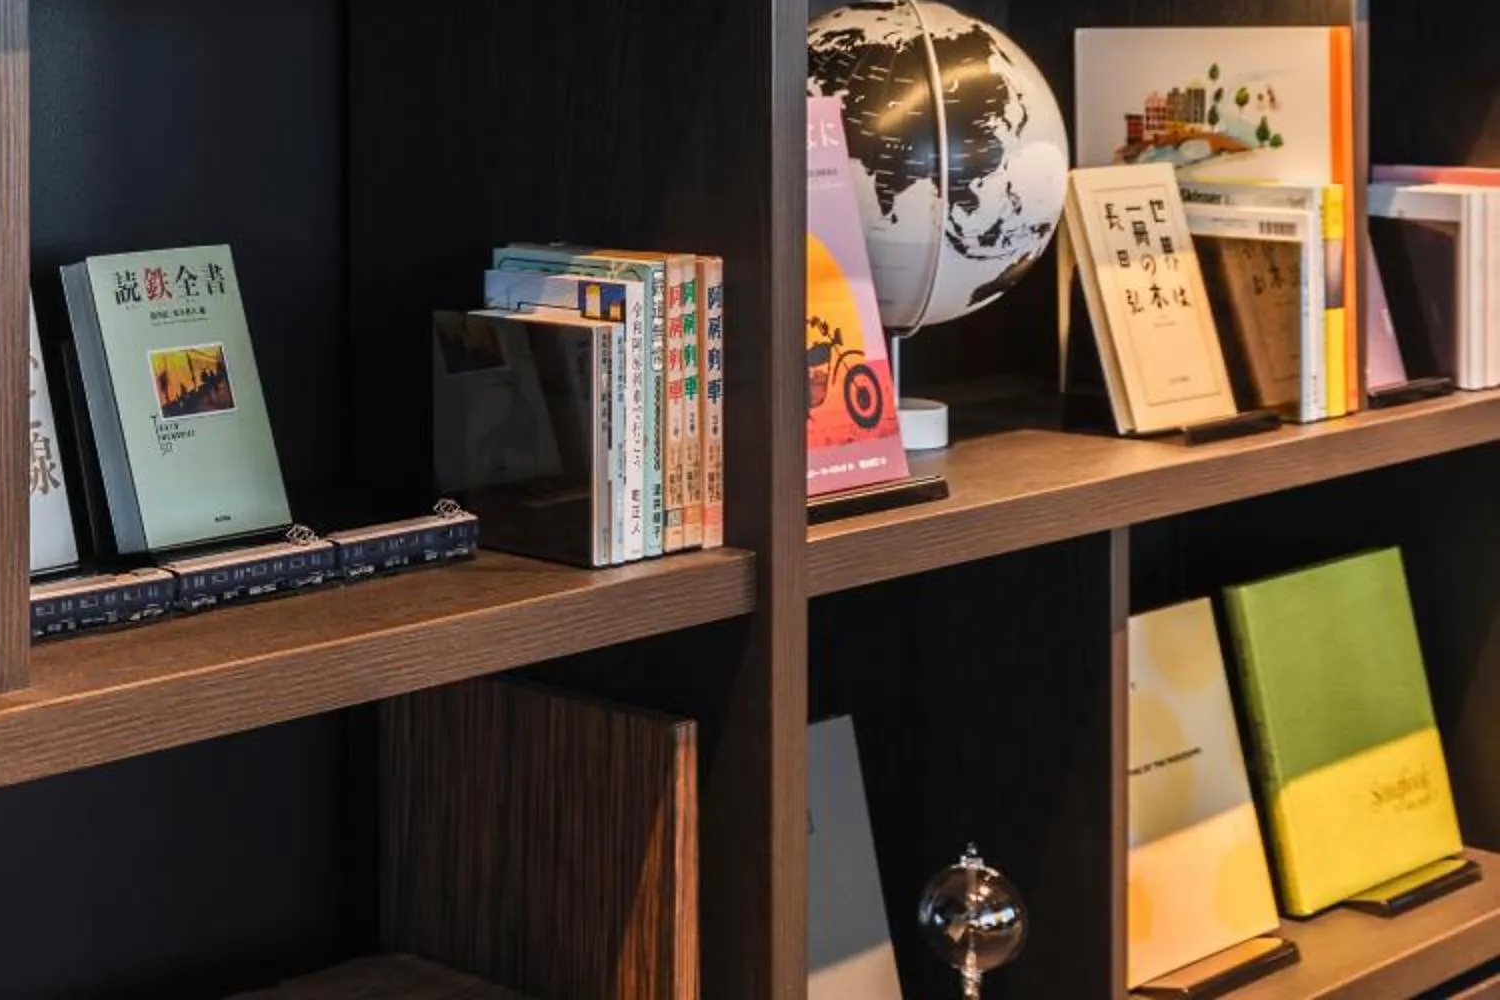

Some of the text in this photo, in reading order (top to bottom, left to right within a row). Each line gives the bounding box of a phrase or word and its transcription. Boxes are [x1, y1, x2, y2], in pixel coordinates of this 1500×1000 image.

[114, 262, 226, 304] 読鉄全書
[1104, 202, 1145, 315] 長田弘
[1124, 206, 1170, 310] 一冊の本
[1148, 199, 1191, 308] 世界は
